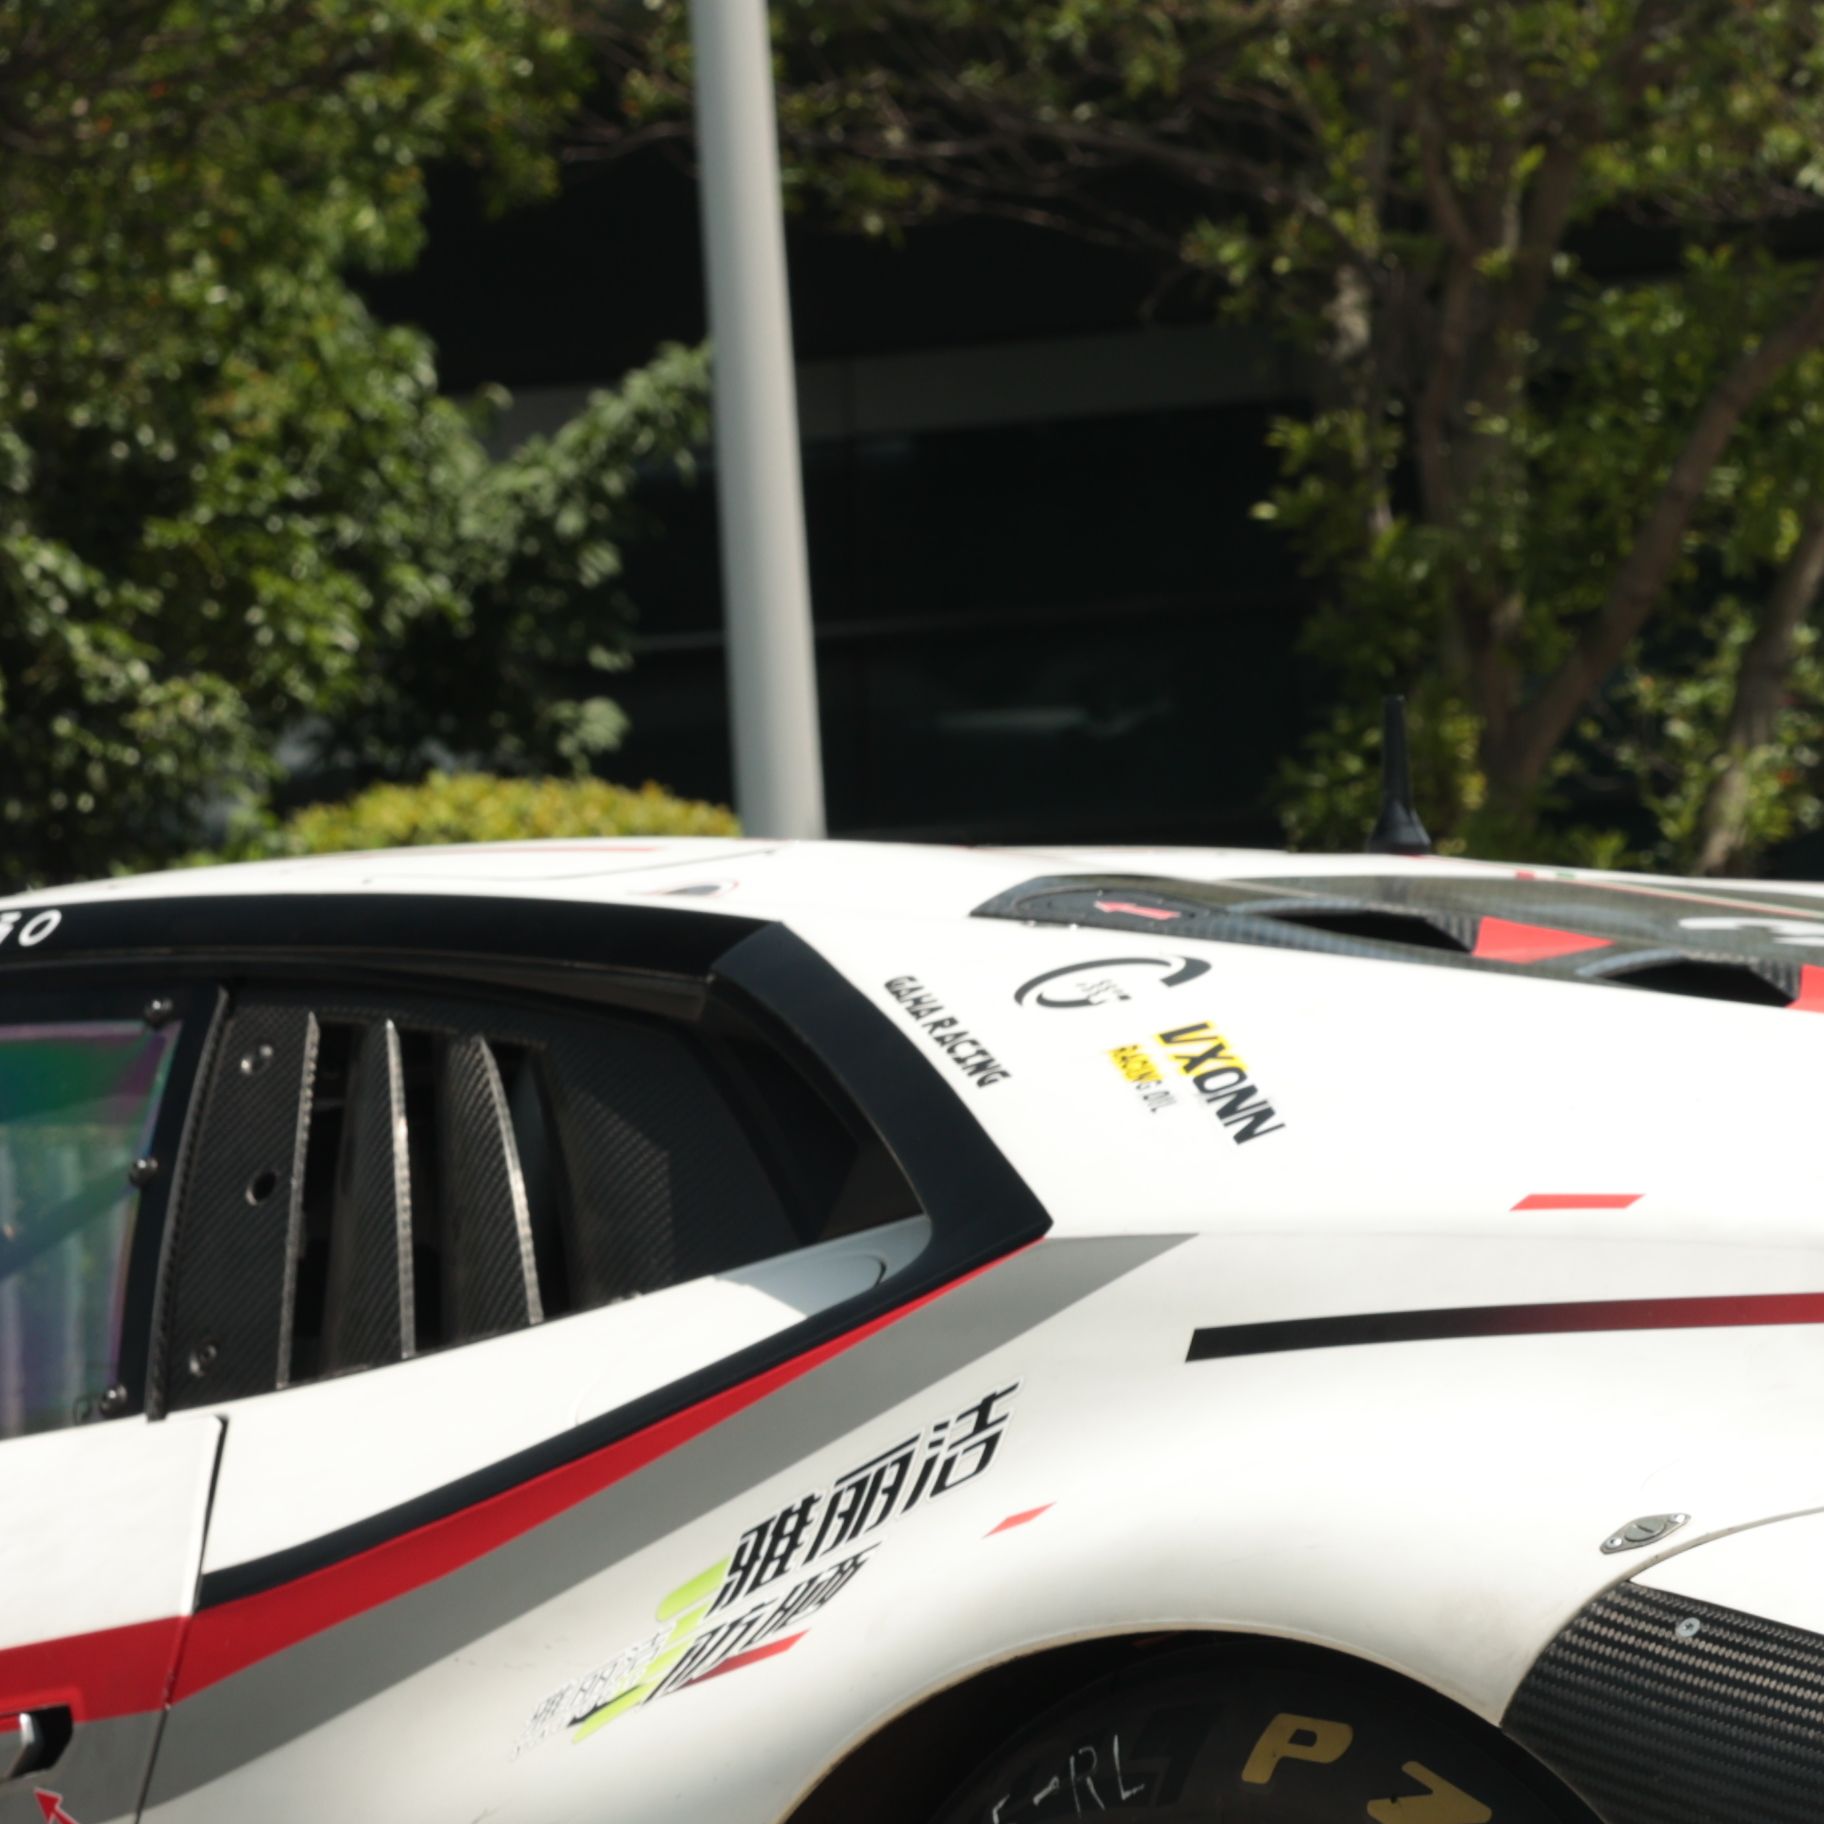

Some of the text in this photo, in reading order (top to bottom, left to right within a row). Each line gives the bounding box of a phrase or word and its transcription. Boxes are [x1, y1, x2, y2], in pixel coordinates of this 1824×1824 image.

[921, 1016, 1012, 1088] RACING
[1156, 1021, 1286, 1145] VXONN
[1240, 1712, 1354, 1785] P
